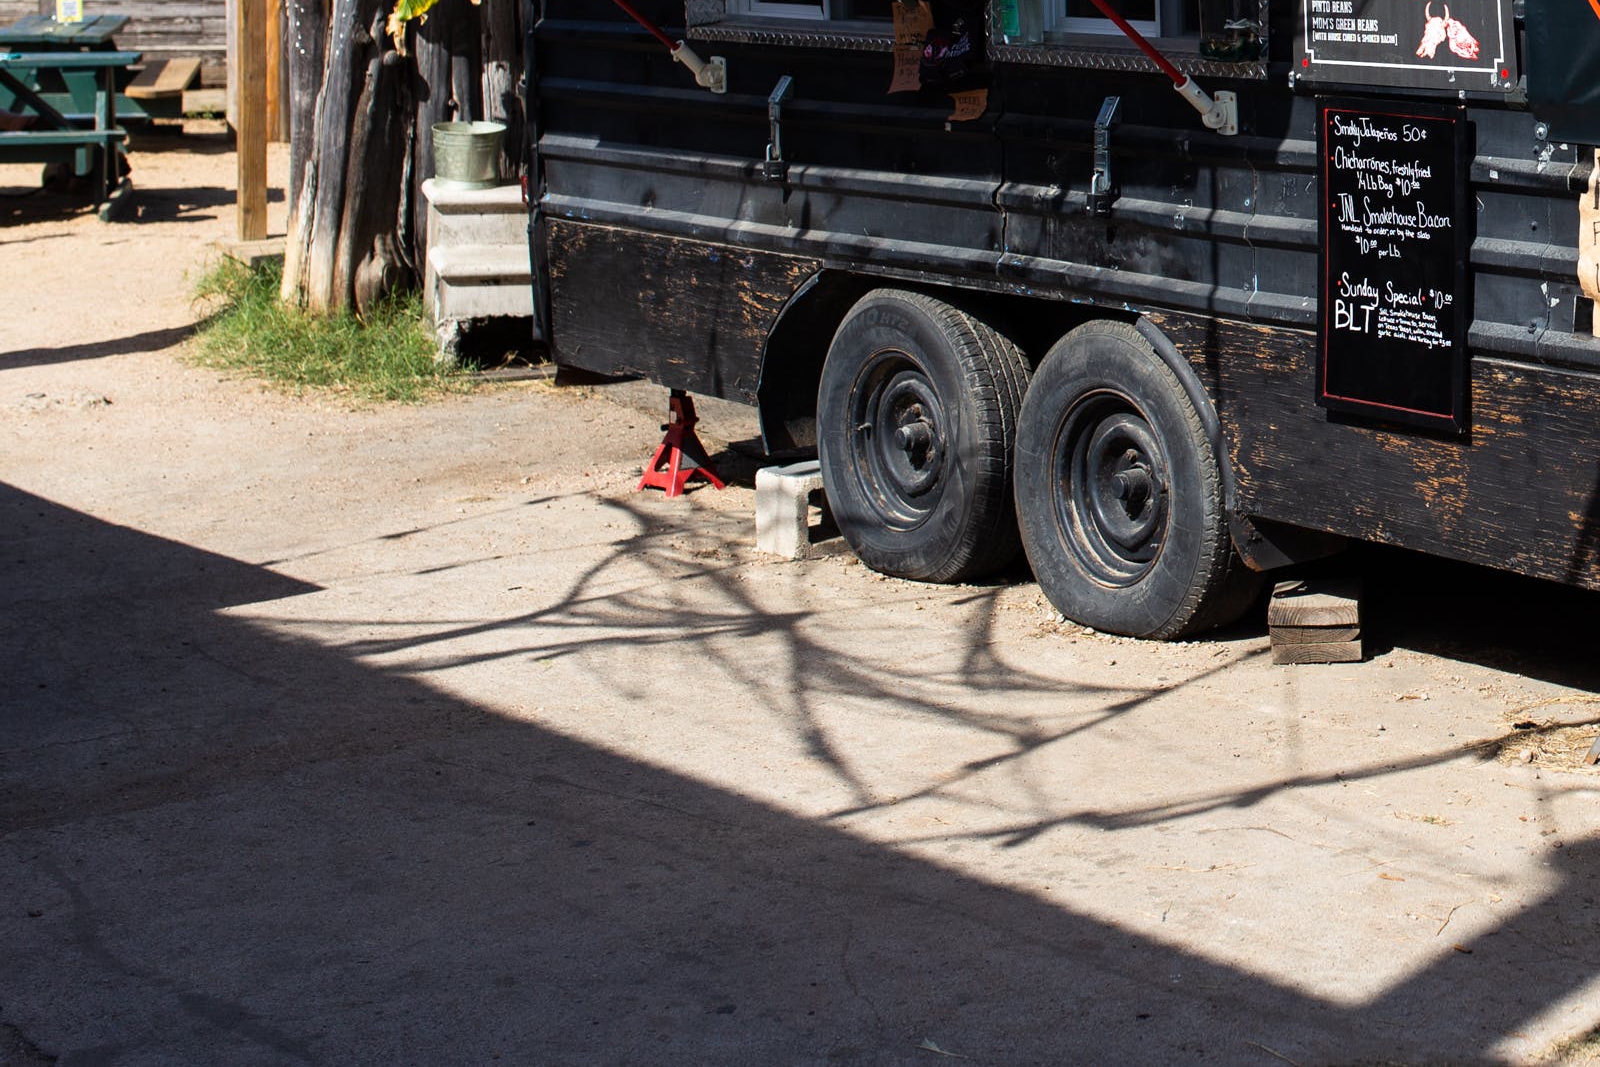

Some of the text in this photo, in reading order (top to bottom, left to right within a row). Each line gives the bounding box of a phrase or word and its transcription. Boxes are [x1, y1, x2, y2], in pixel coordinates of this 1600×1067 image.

[1311, 1, 1353, 14] PINTO BEANS
[1312, 17, 1379, 32] MOM'S GREEN BEANS
[1414, 160, 1431, 178] fried
[1378, 174, 1394, 198] Bag
[1337, 193, 1451, 228] JNL Smokehouse Bacon
[1397, 228, 1405, 241] by
[1405, 229, 1415, 238] the
[1378, 248, 1388, 259] per
[1340, 271, 1379, 307] Sunday
[1385, 281, 1422, 308] Special
[1335, 299, 1375, 333] BLT
